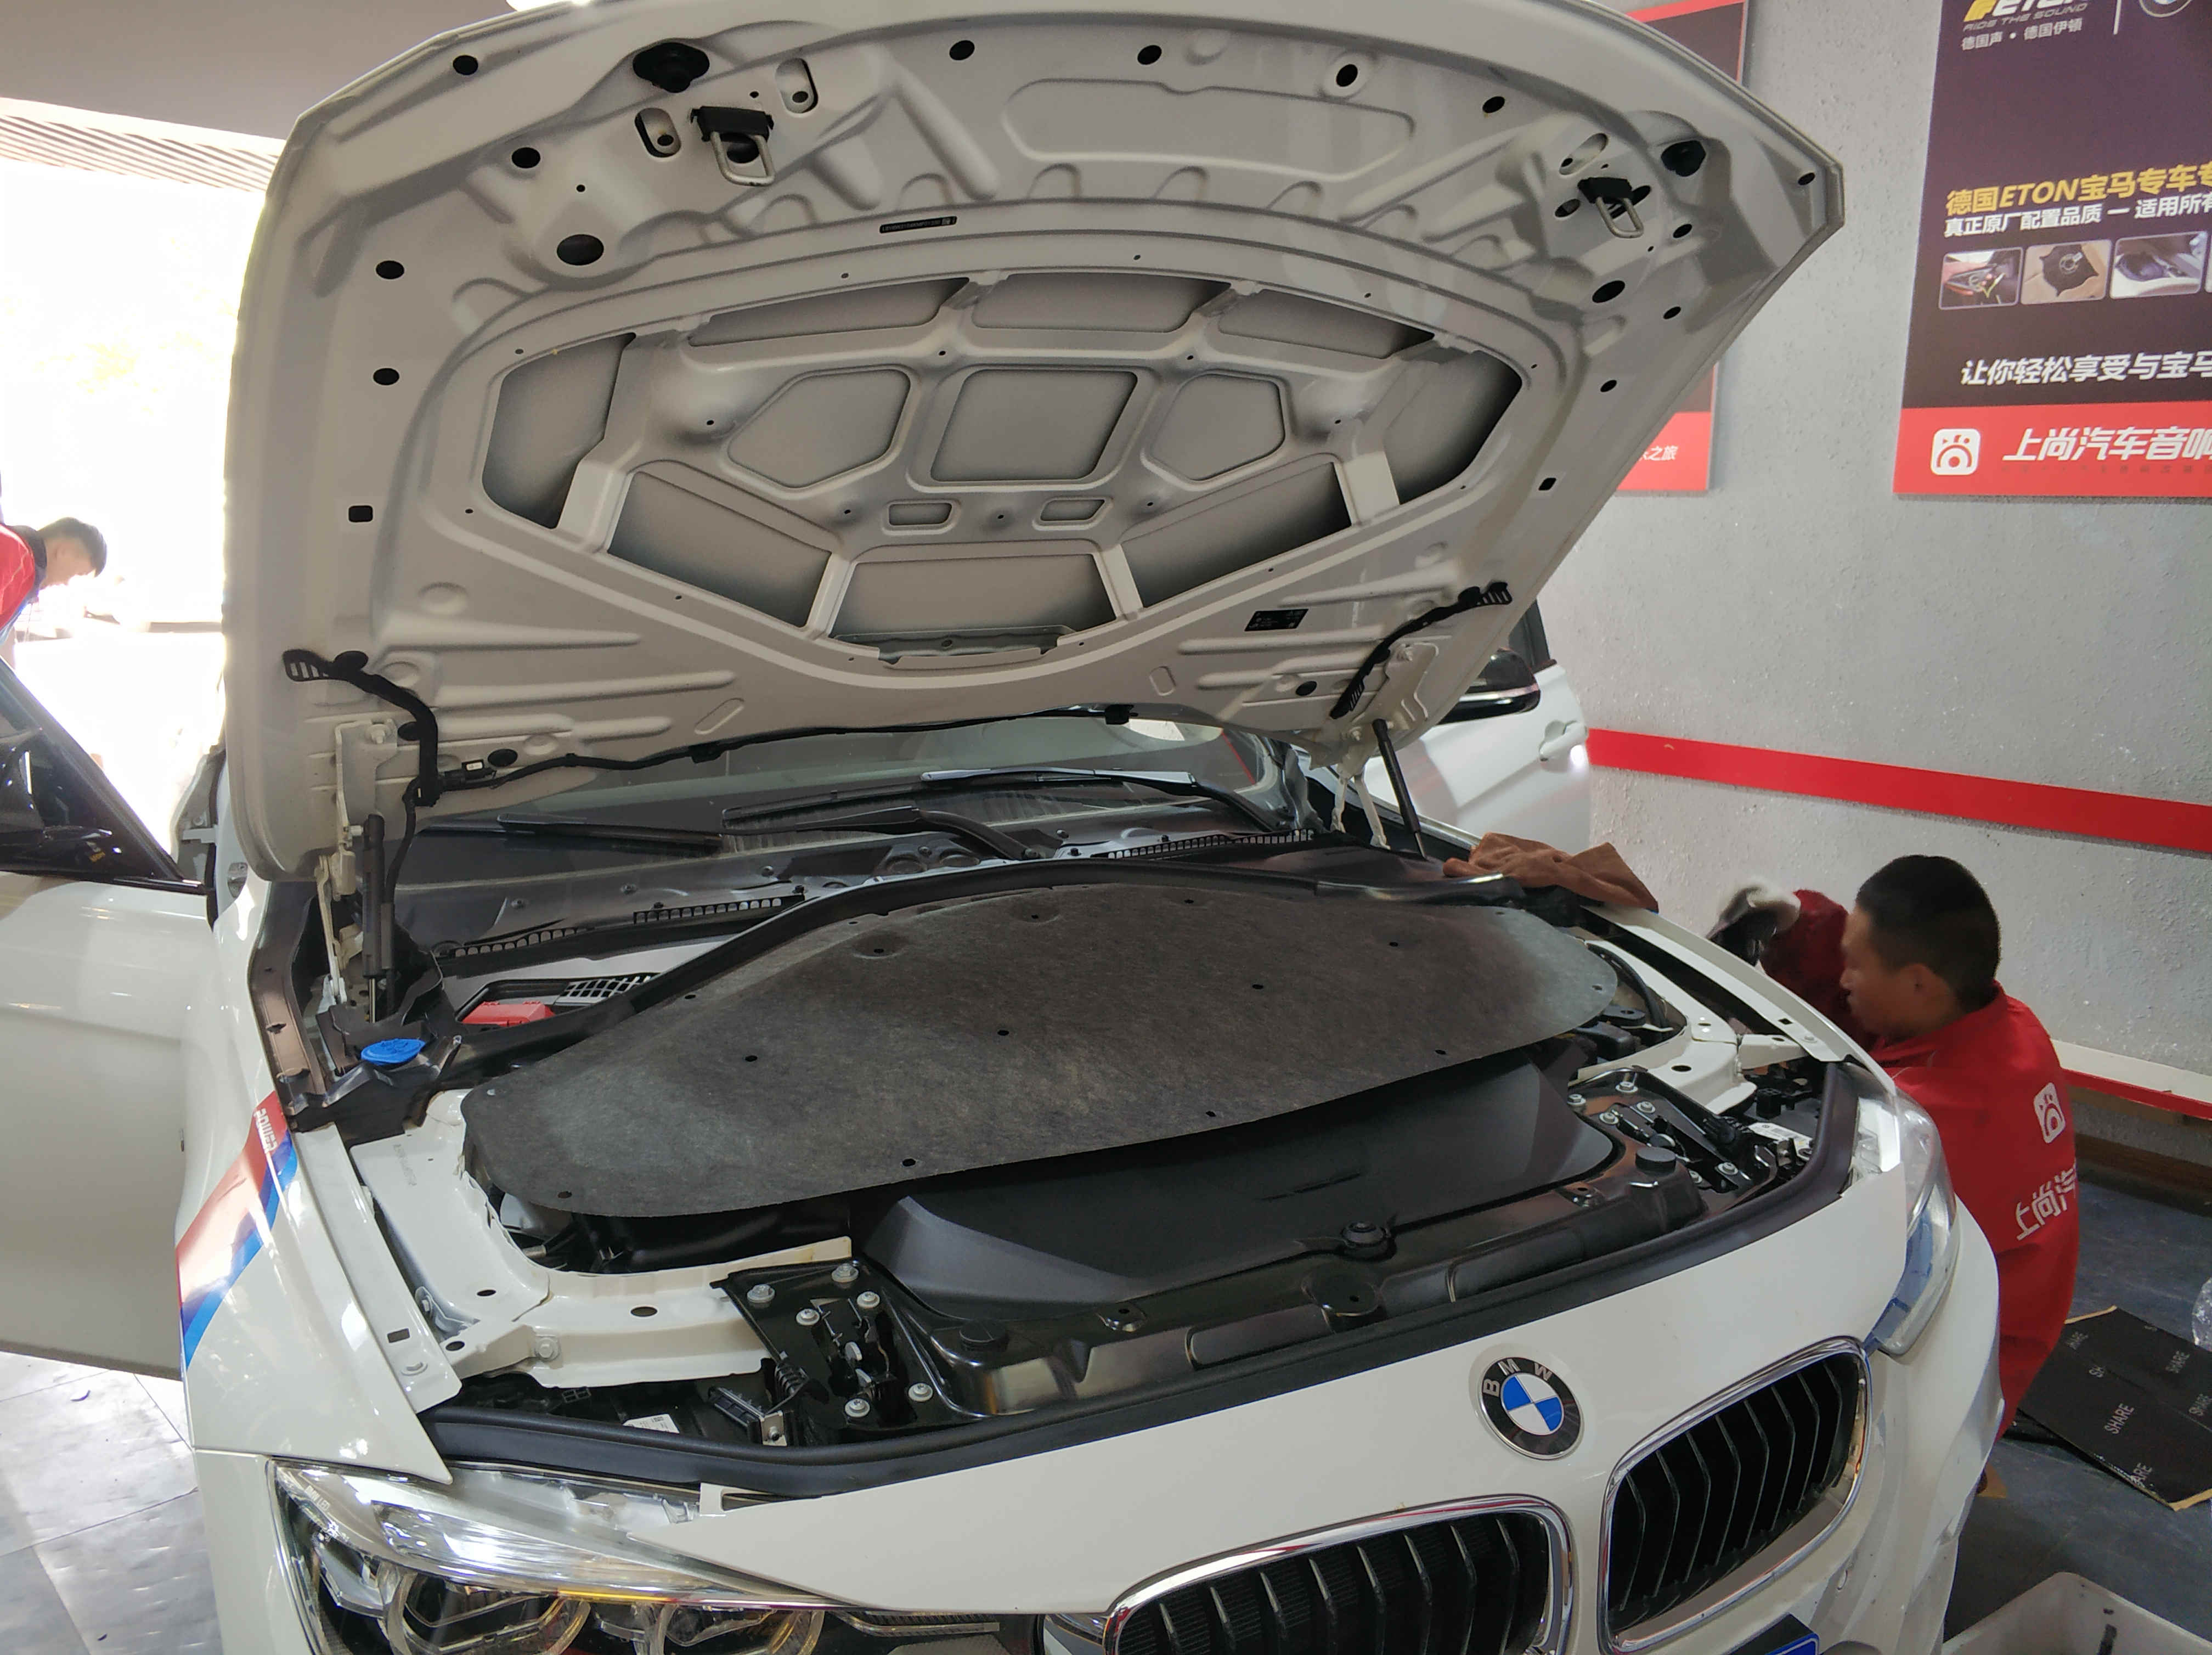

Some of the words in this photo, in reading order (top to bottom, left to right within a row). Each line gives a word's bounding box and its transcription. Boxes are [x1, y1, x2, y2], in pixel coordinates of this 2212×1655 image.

[2001, 13, 2032, 26] THE
[2032, 3, 2088, 20] SOUND
[1482, 1358, 1553, 1398] BMW
[2104, 1403, 2135, 1434] SHARE
